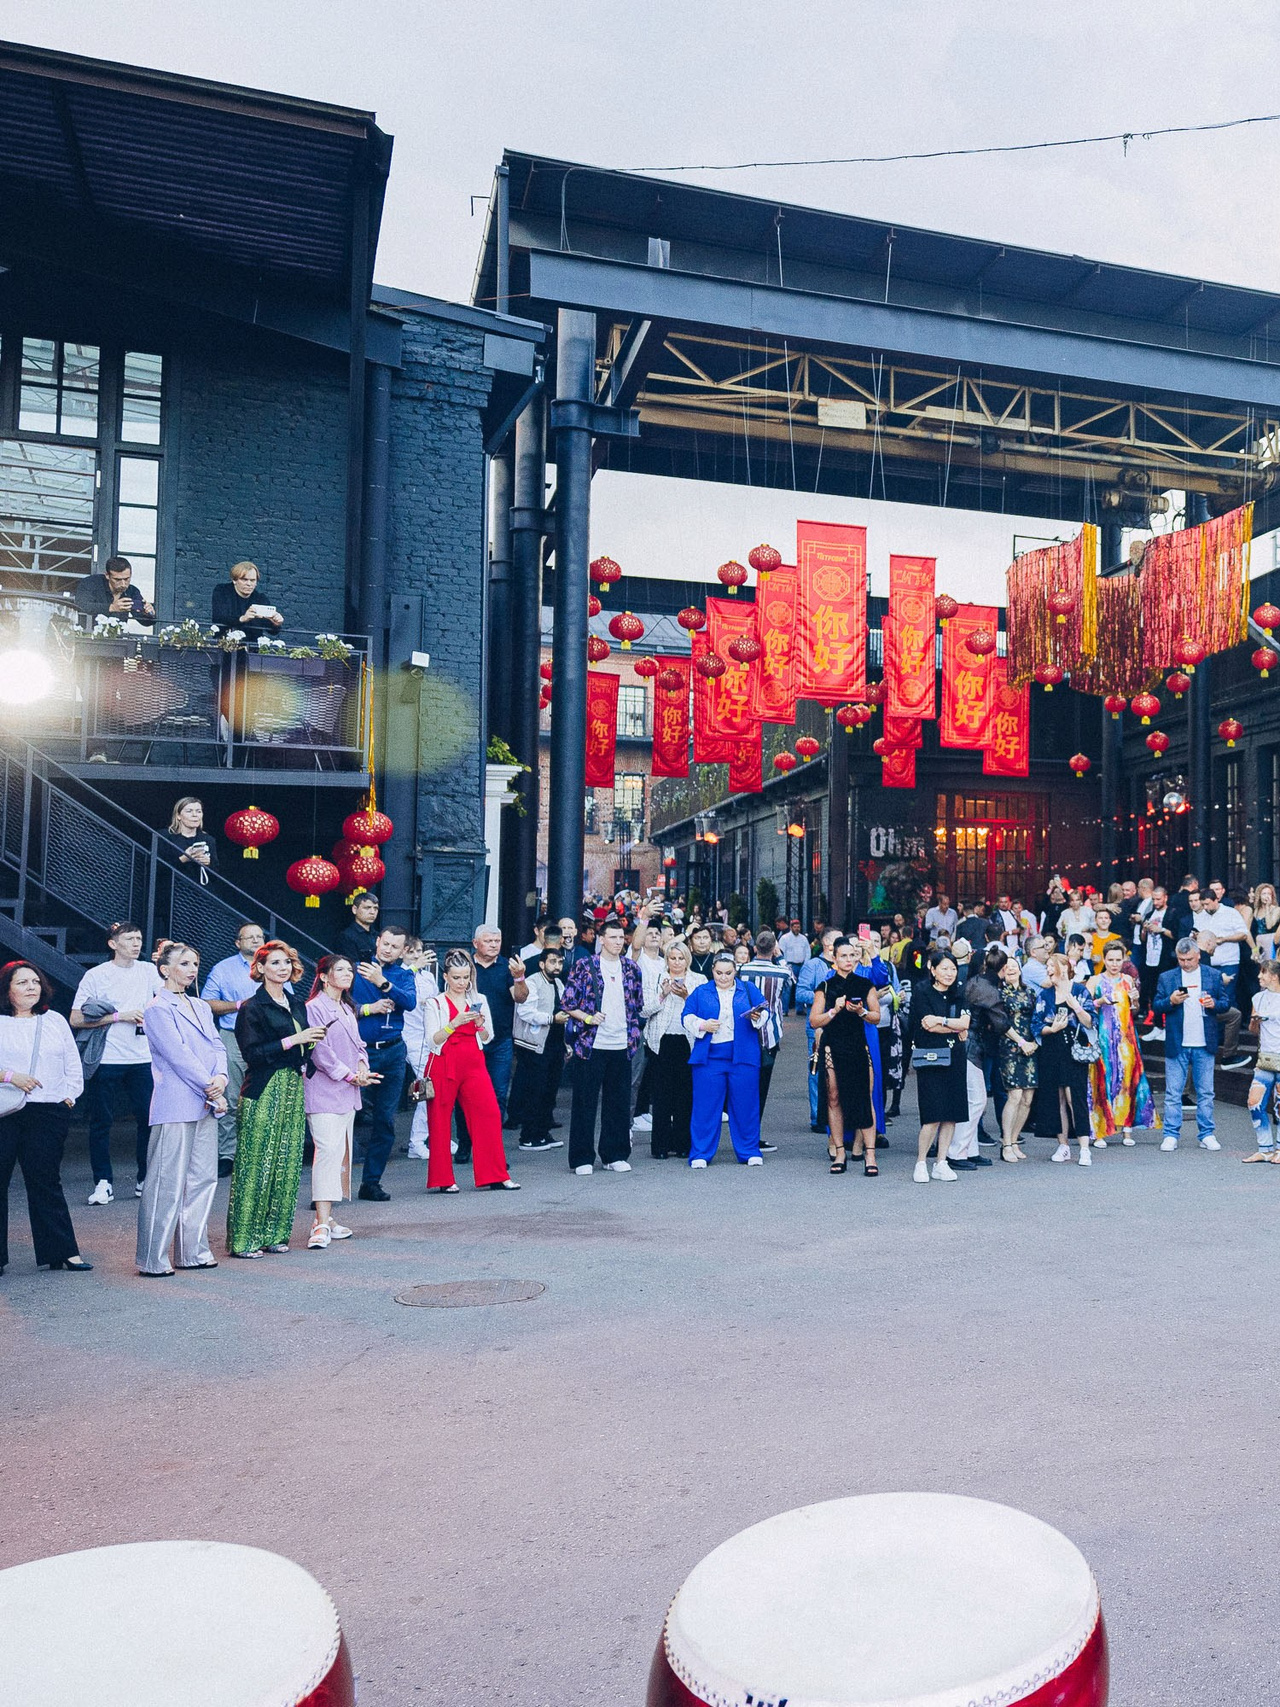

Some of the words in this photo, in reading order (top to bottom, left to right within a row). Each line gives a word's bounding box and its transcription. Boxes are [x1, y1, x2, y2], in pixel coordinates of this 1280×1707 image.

[763, 628, 790, 679] 你好
[811, 604, 853, 675] 你好
[900, 624, 925, 677] 你好
[716, 666, 749, 723] 你好
[954, 670, 986, 729] 你好
[589, 718, 609, 756] 你好
[662, 706, 683, 744] 你好
[995, 711, 1020, 759] 你好
